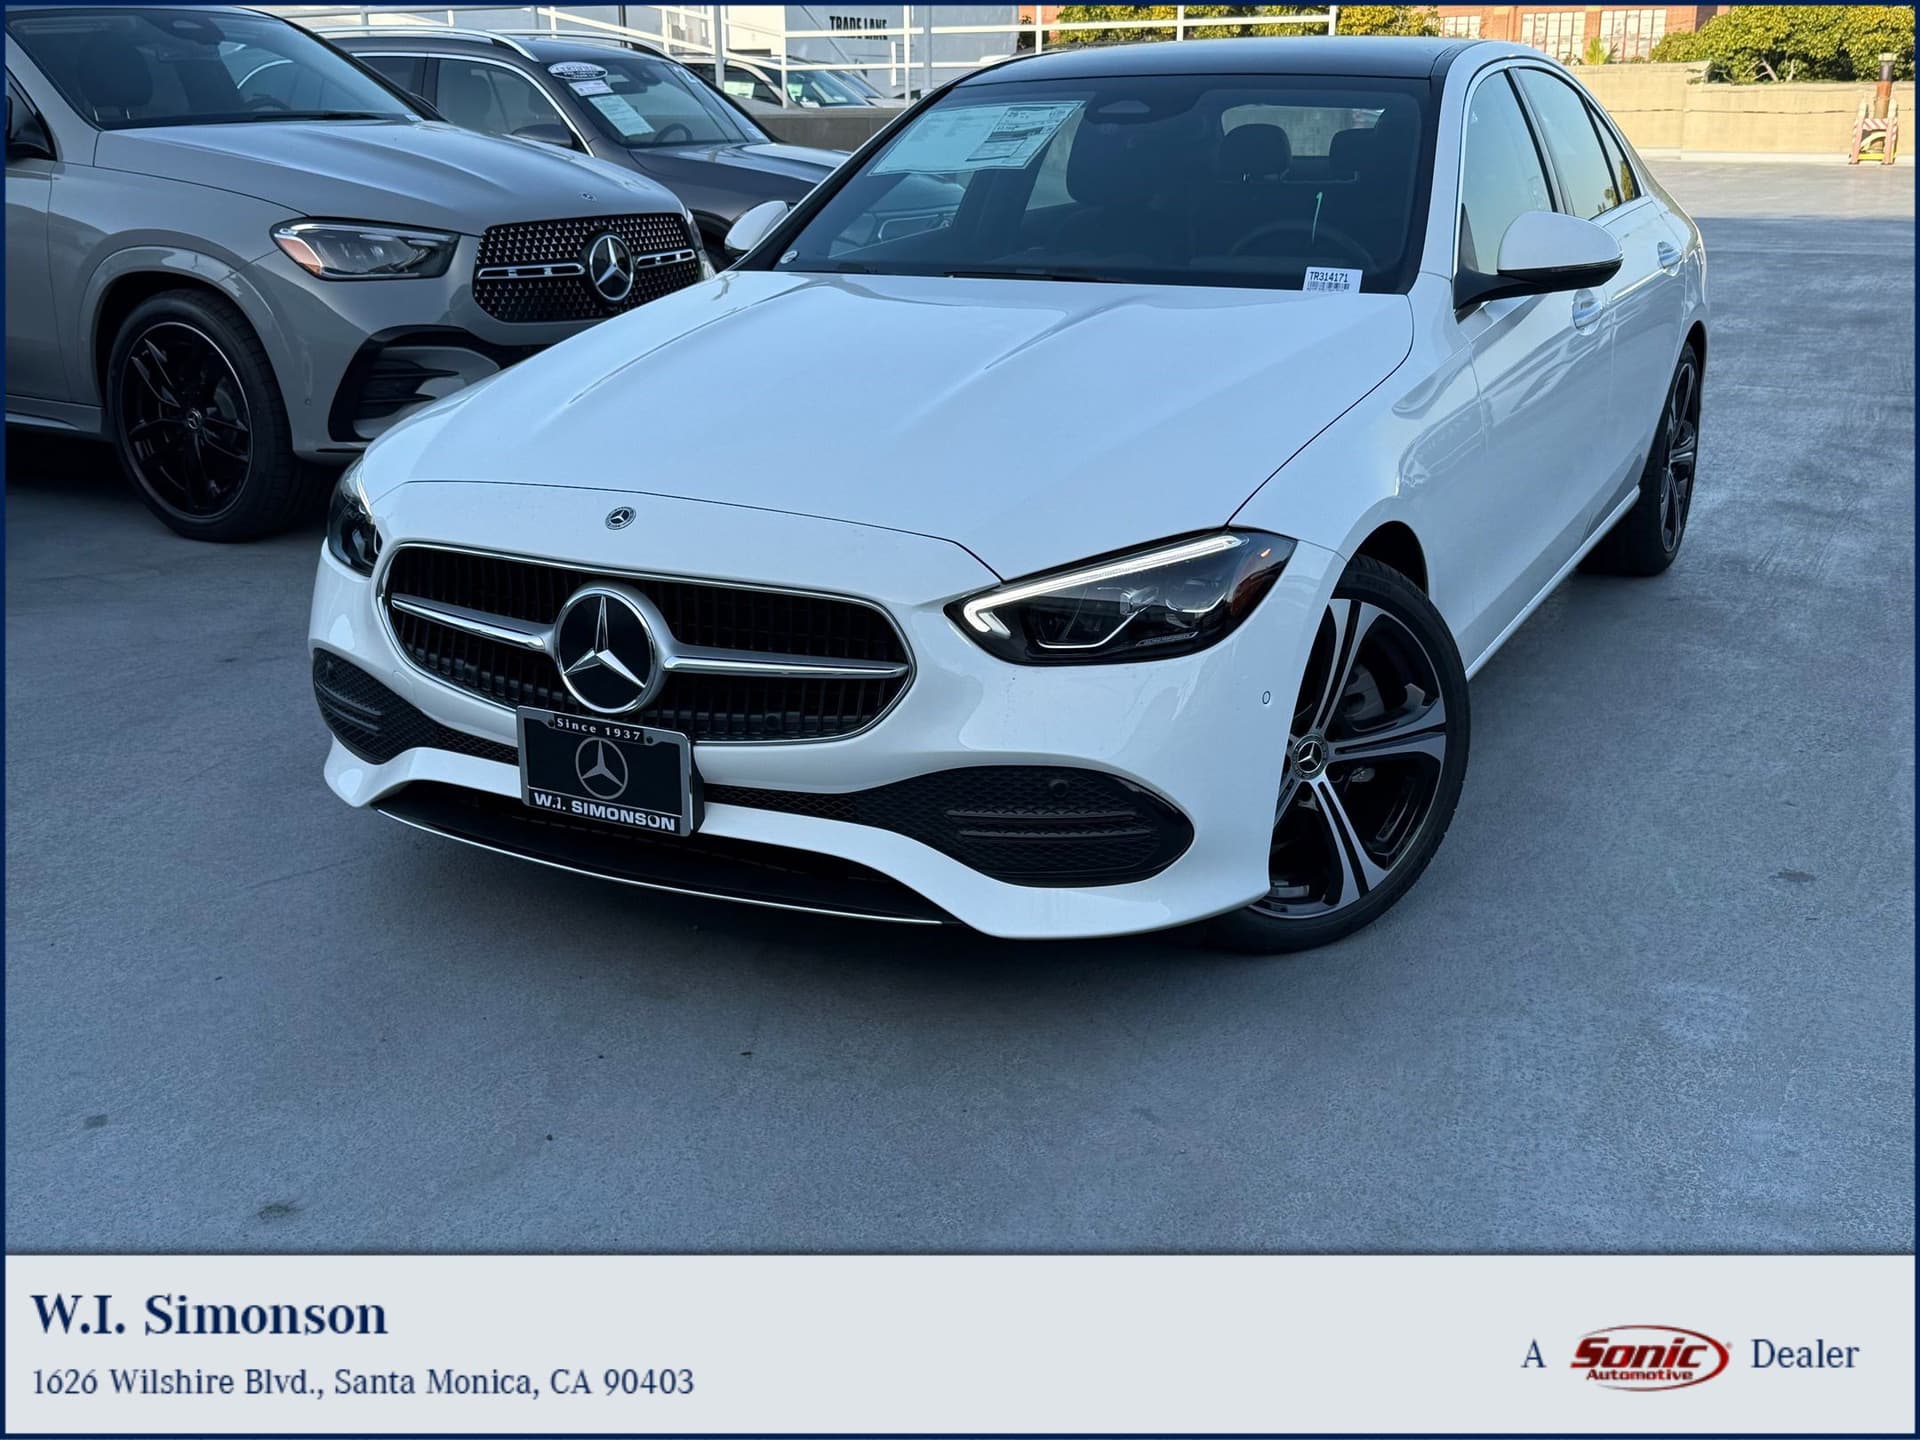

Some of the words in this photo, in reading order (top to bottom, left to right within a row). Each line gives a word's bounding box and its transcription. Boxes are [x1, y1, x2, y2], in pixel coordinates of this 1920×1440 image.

[829, 16, 862, 39] TRADE
[1310, 271, 1349, 283] TR314171
[557, 717, 597, 734] Since
[604, 726, 641, 741] 1937
[571, 800, 675, 832] SIMONSON
